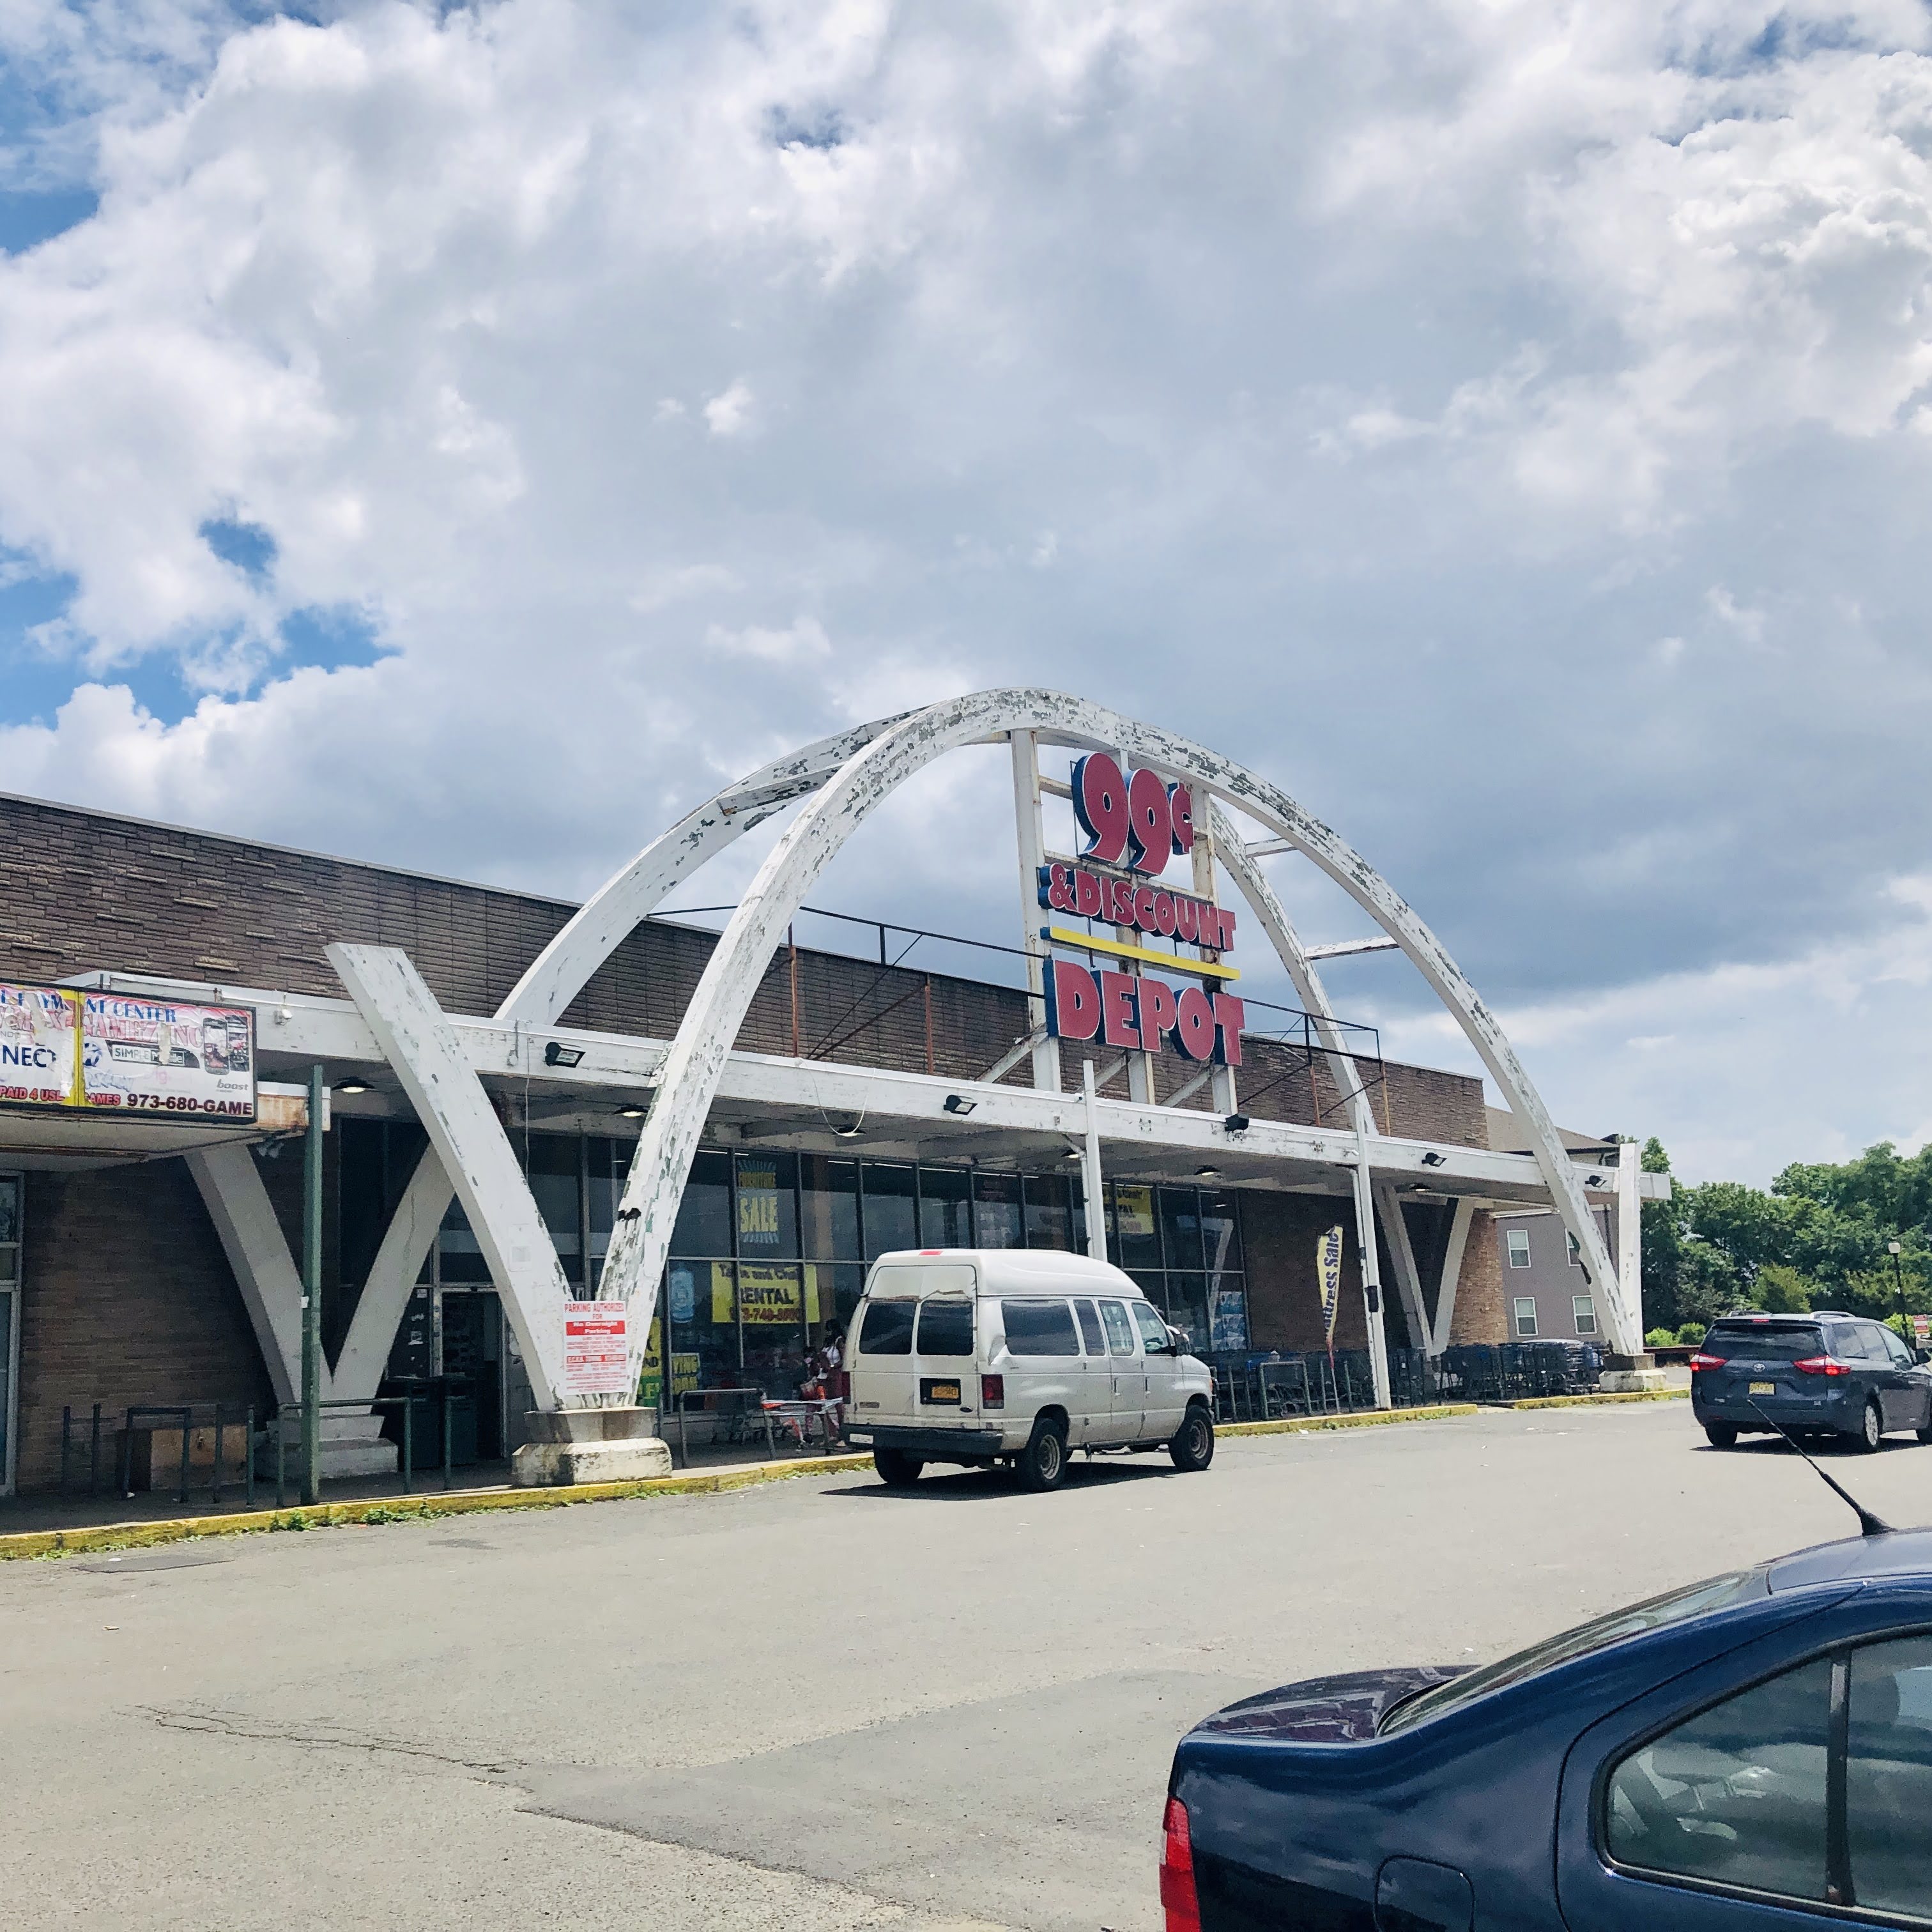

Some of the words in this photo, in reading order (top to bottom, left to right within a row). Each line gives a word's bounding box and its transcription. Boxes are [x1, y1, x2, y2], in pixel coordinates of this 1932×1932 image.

[113, 1002, 176, 1023] CENTER
[1054, 959, 1245, 1066] DEPOT
[114, 1047, 150, 1061] SIMPLE
[216, 1078, 249, 1091] boost
[0, 1085, 28, 1100] PAID
[29, 1087, 38, 1101] 4
[127, 1093, 253, 1116] 973-680-GAME
[739, 1196, 778, 1233] SALE
[1323, 1232, 1339, 1268] Sale
[564, 1303, 591, 1313] PARKING
